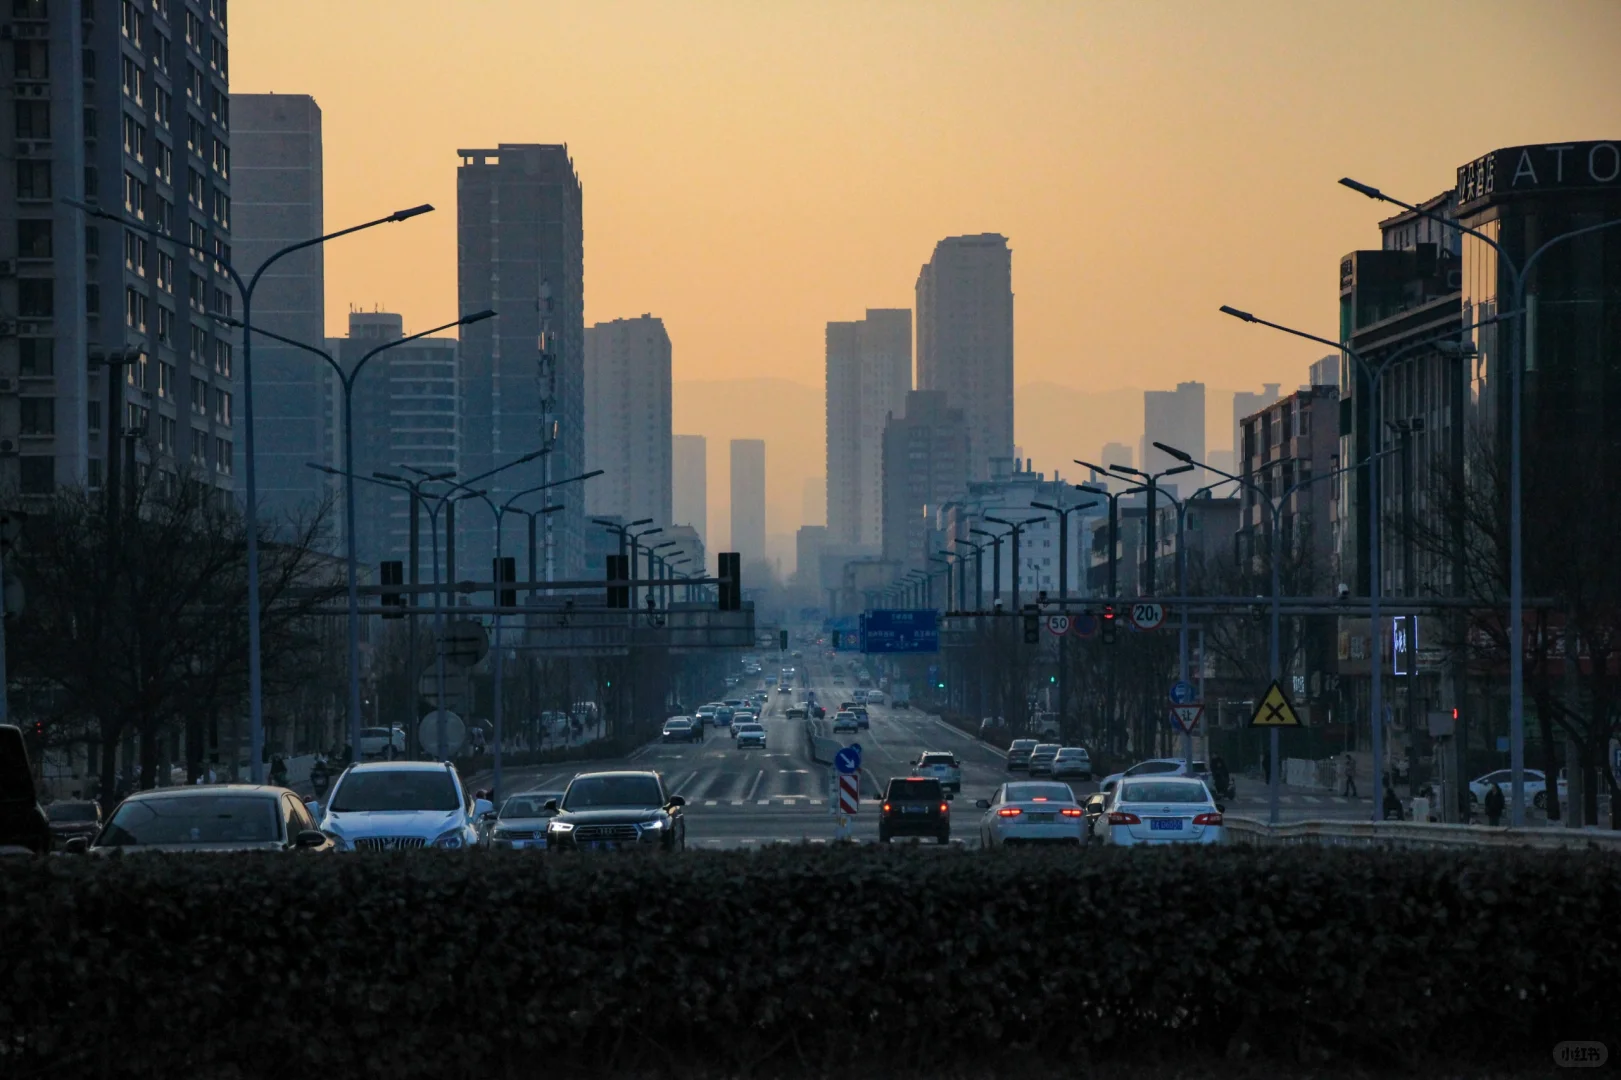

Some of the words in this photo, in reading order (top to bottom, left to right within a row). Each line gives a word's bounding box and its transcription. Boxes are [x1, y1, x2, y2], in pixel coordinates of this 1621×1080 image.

[1511, 143, 1621, 187] ATO
[1136, 605, 1159, 621] 20t
[1052, 618, 1067, 629] 50
[1181, 709, 1193, 721] 让
